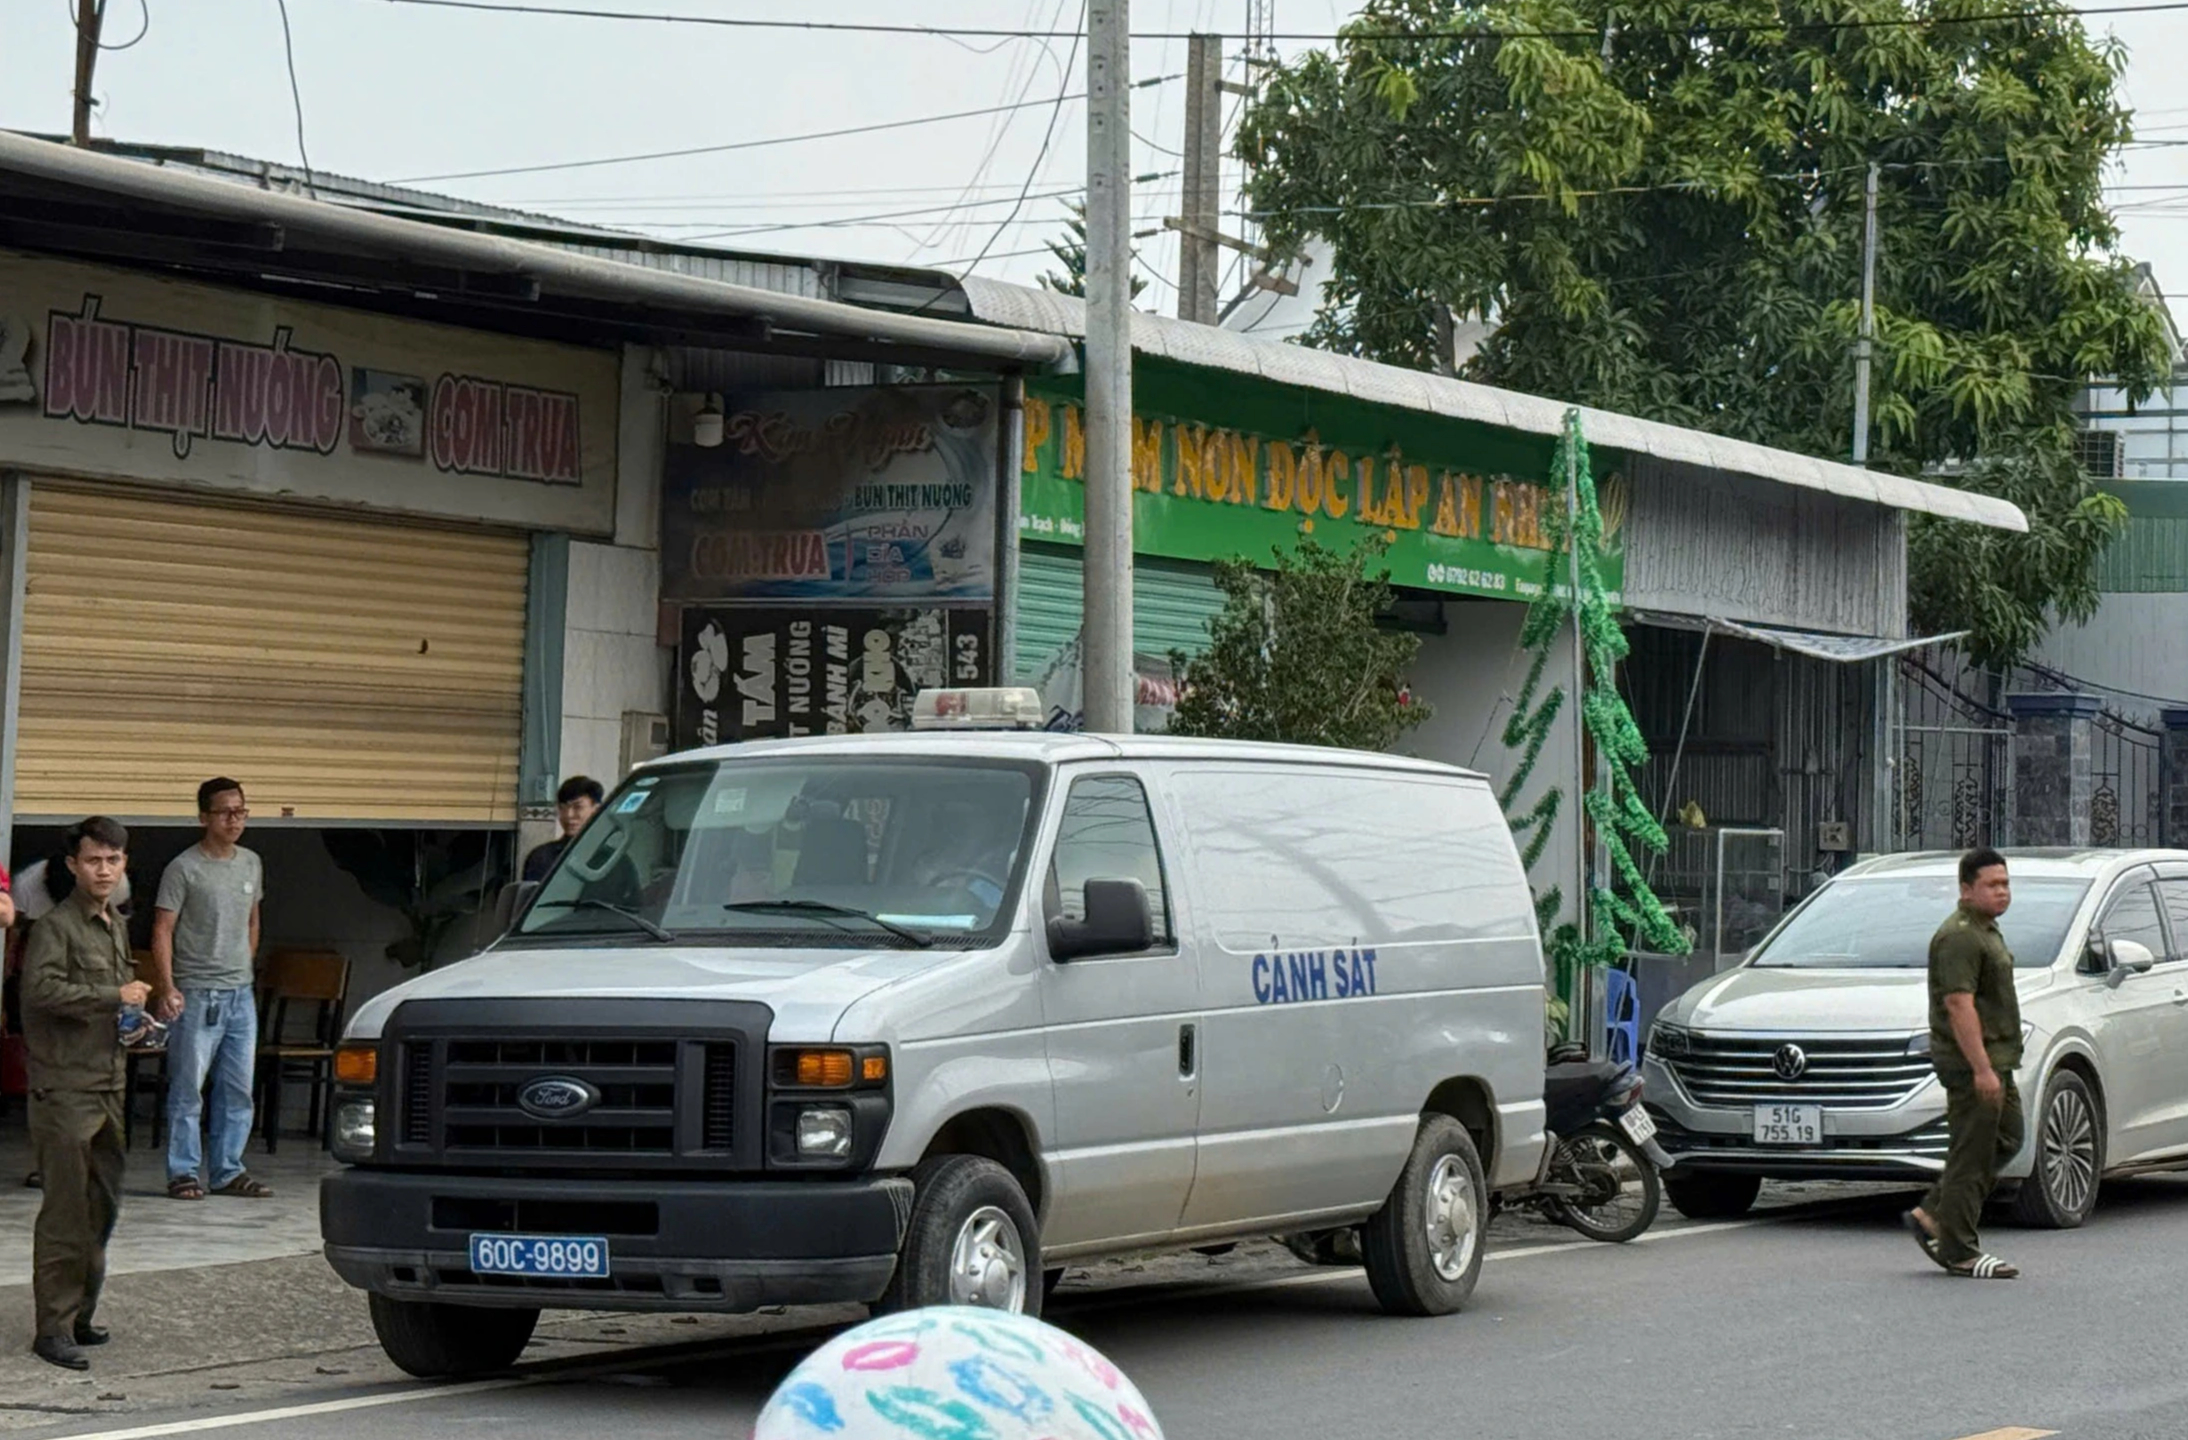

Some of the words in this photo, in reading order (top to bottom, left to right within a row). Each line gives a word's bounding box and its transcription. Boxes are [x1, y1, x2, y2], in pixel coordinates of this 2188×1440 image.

[44, 292, 129, 424] BÚN
[131, 325, 212, 458] THỊT
[1063, 403, 1163, 493] MM
[1173, 423, 1259, 505] NON
[1265, 426, 1349, 533] ĐỘC
[1355, 443, 1430, 543] LẬP
[1432, 468, 1482, 540] AN
[784, 620, 812, 713] NƯỚNG
[821, 624, 848, 660] MÌ
[956, 634, 979, 680] 543
[820, 663, 848, 735] BÁNH
[1252, 934, 1328, 1004] CẢNH
[1333, 936, 1377, 998] SÁT
[1760, 1124, 1814, 1142] 755.19
[1771, 1107, 1801, 1125] 51G
[478, 1239, 600, 1273] 60C-9899
